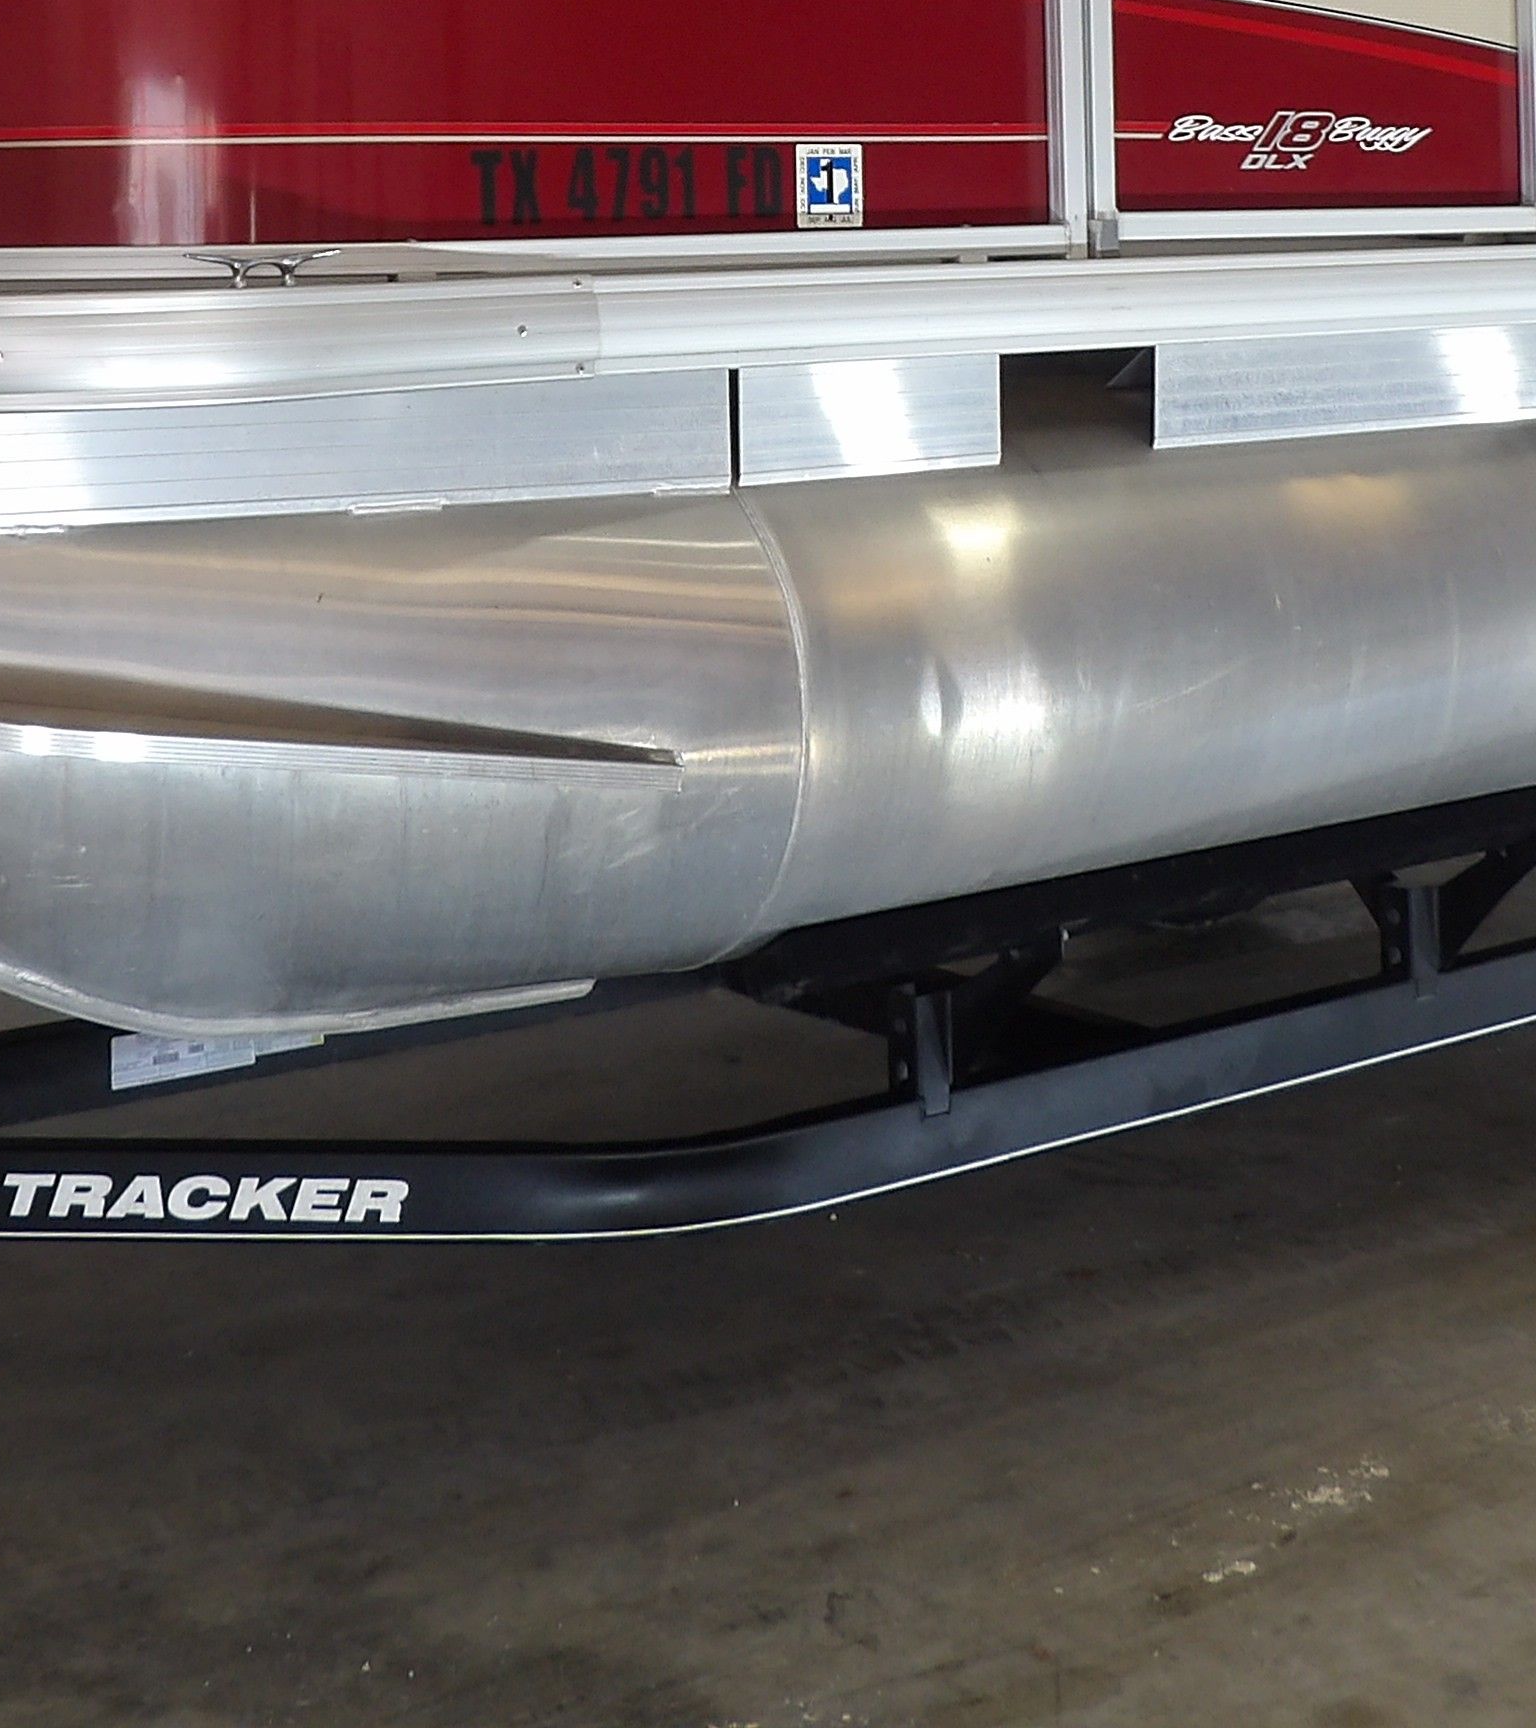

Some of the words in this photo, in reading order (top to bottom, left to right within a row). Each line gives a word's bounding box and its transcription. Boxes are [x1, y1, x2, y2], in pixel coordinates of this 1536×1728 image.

[1168, 114, 1265, 142] Bass
[1251, 110, 1336, 152] 18
[1328, 116, 1433, 153] Buggy
[470, 148, 541, 224] TX
[566, 145, 695, 221] 4791
[1240, 153, 1314, 170] DLX
[2, 1172, 410, 1223] TRACKER
